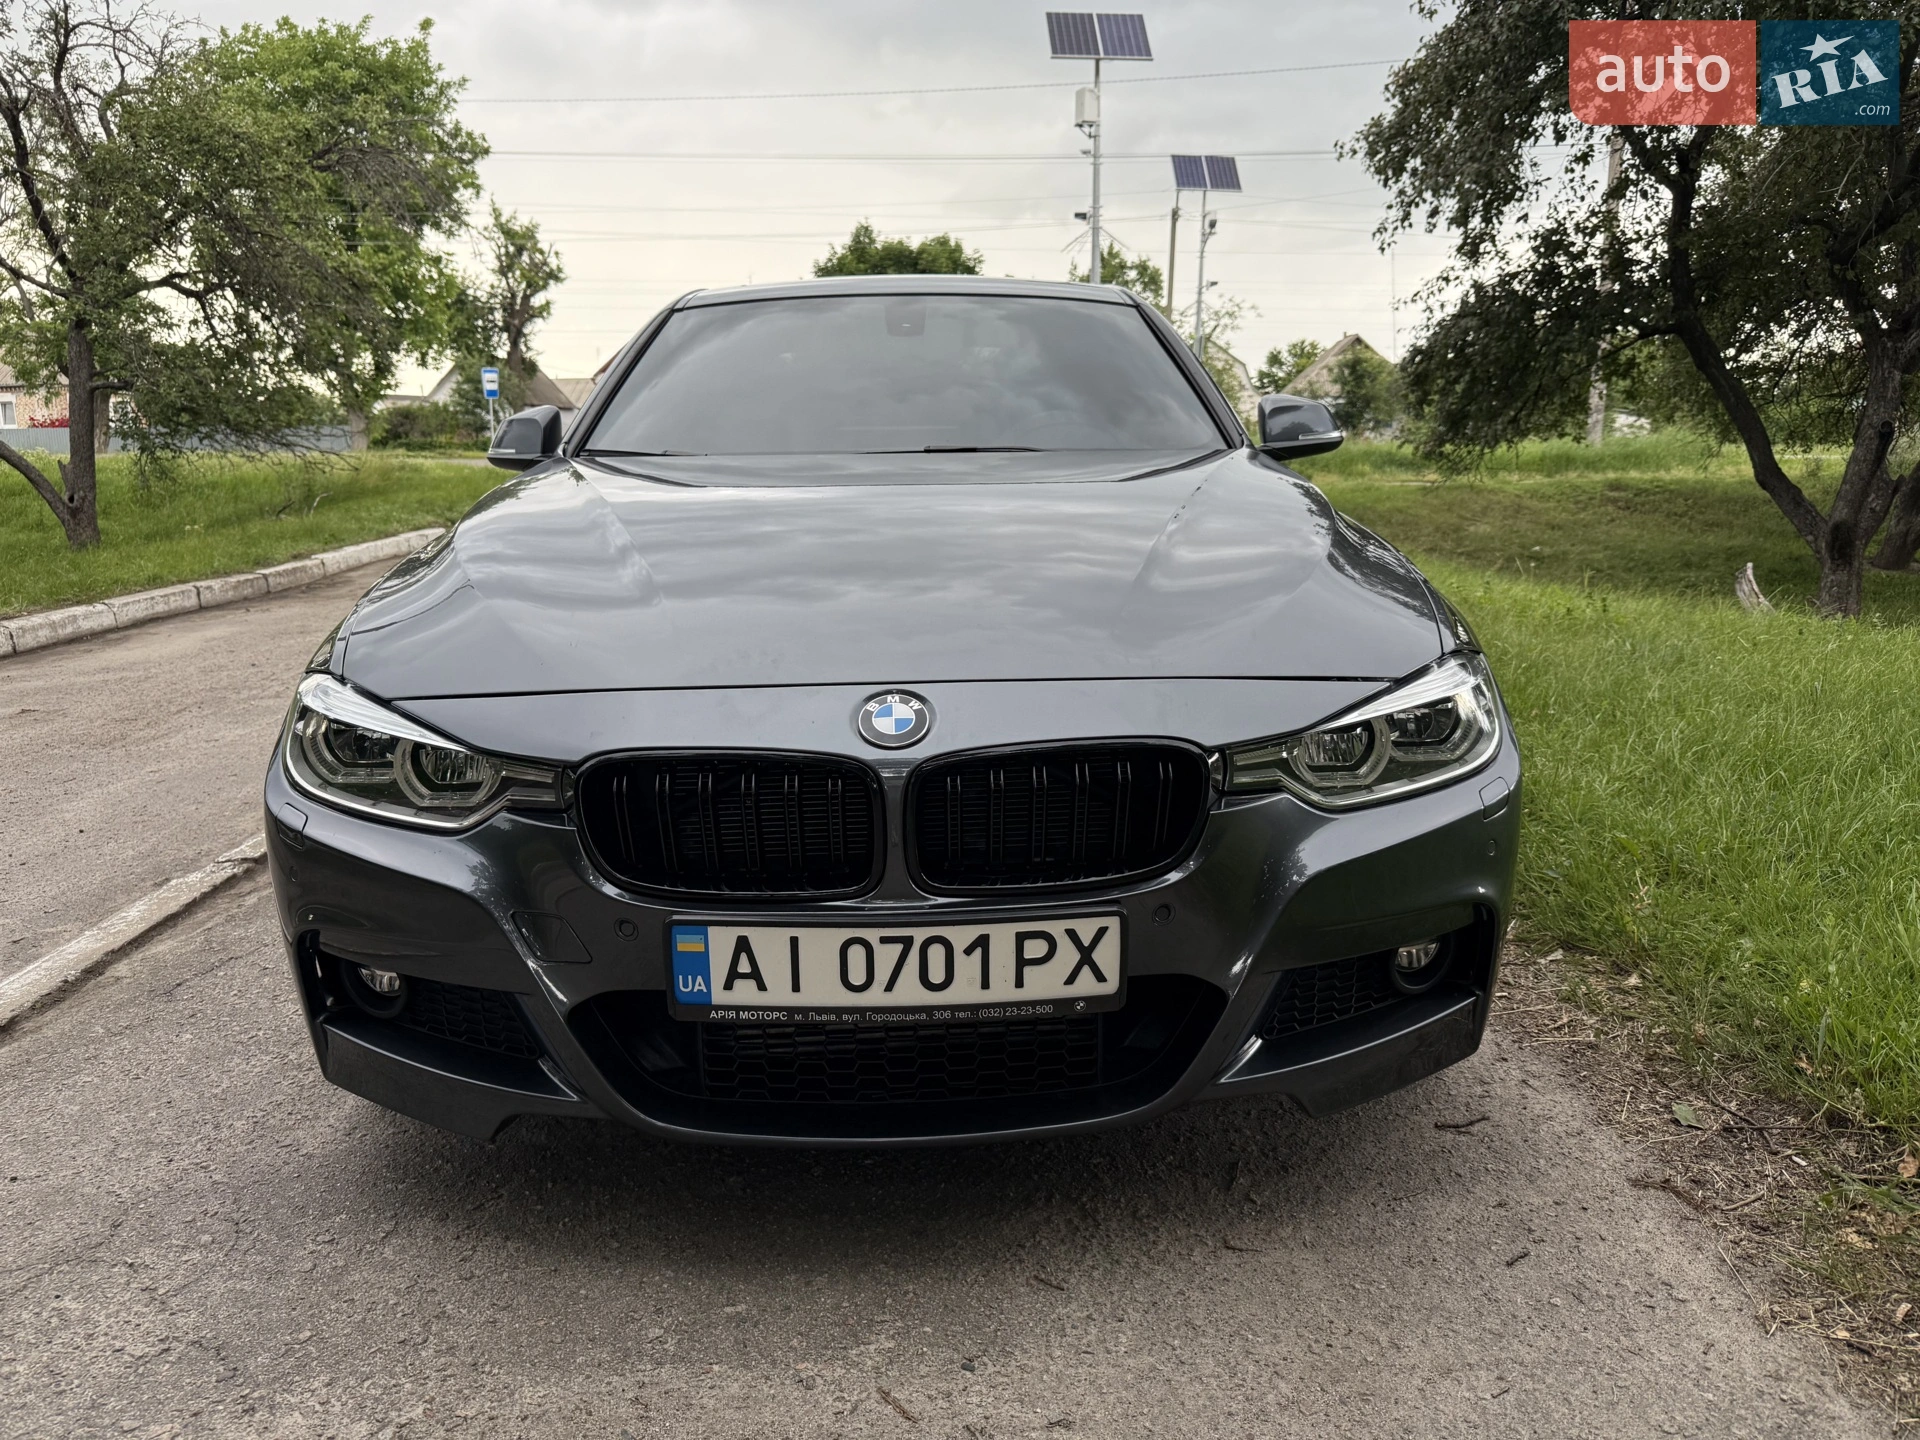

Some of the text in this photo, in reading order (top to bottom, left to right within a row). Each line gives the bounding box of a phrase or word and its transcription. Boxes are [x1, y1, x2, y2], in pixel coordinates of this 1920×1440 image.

[866, 695, 922, 712] BMW
[722, 925, 1110, 994] AI 0701 PX
[678, 975, 707, 993] UA
[709, 1004, 1054, 1023] АРІЯ МОТОРС м. Львів, вул. Городоцька, 306 тел.: (032) 23-23-500
